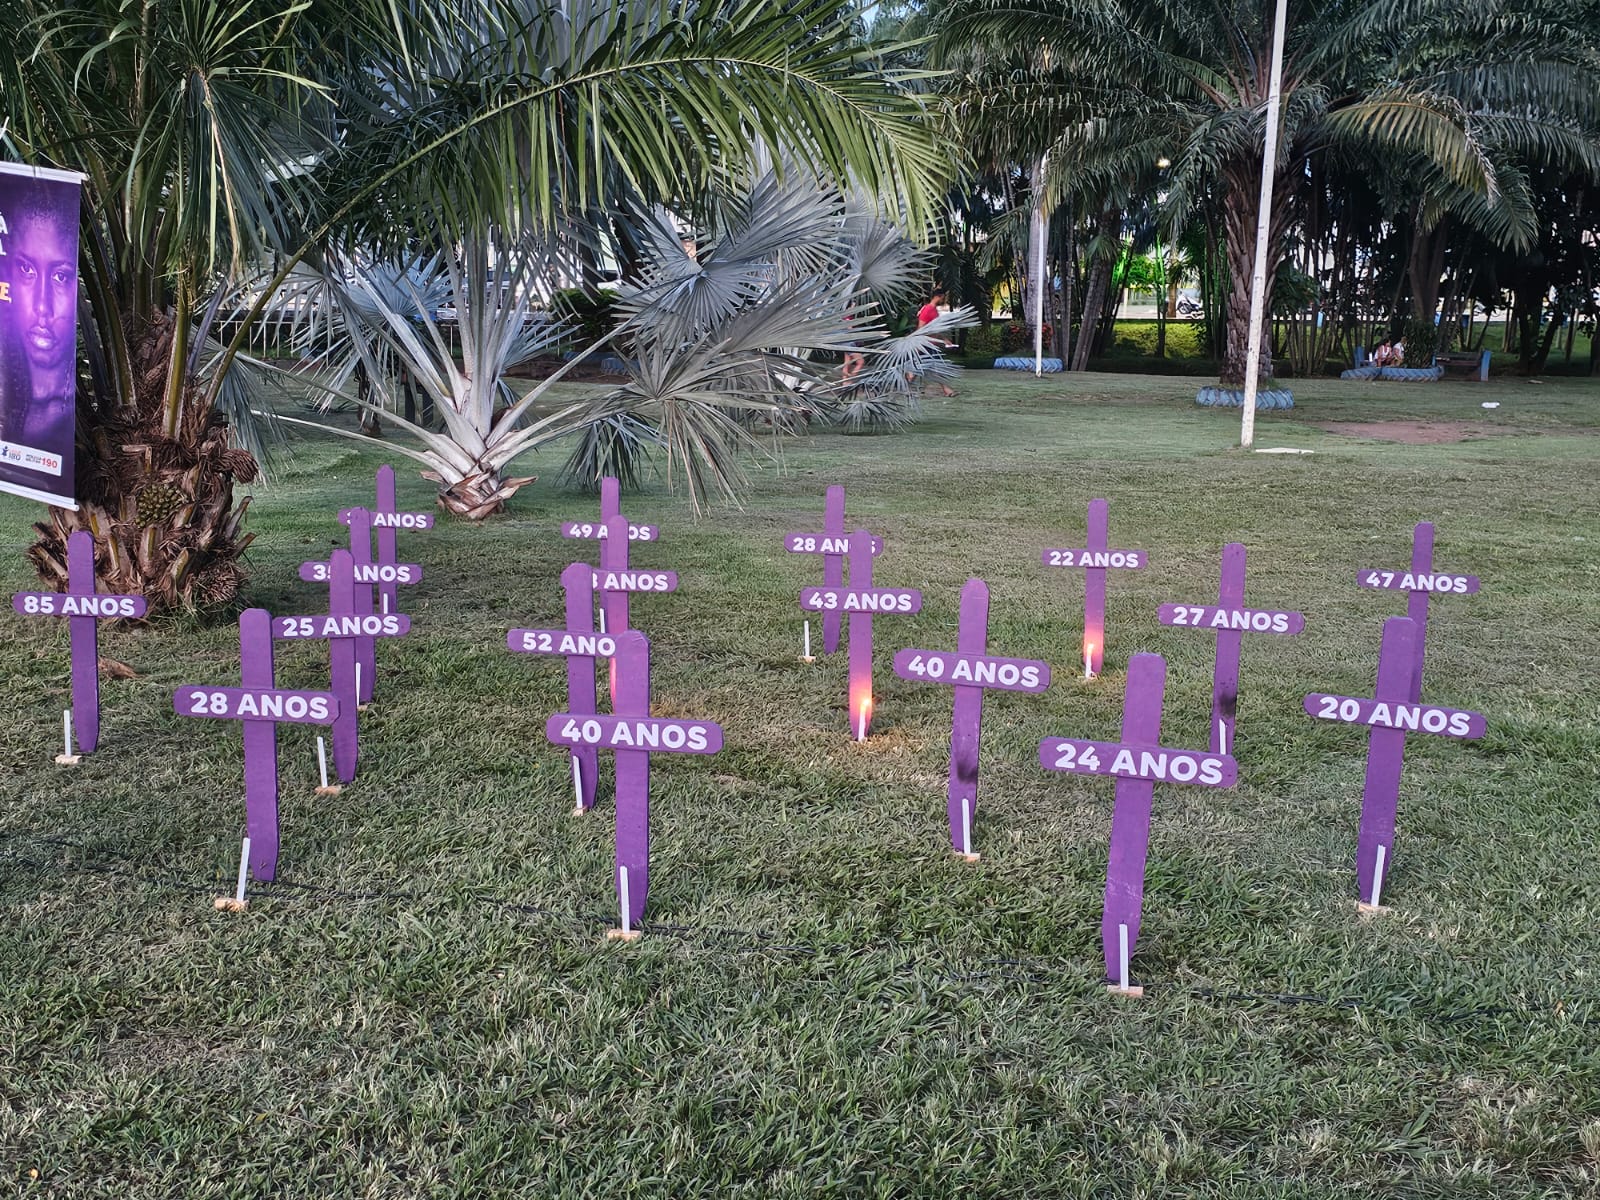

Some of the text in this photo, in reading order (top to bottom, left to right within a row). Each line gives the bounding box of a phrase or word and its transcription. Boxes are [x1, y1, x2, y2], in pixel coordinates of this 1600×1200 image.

[42, 457, 58, 469] 190
[373, 512, 427, 529] ANOS
[569, 523, 651, 541] 49 AOS
[793, 537, 875, 555] 28 AN
[1050, 551, 1139, 568] 22 ANOS
[312, 564, 331, 580] 3
[603, 573, 669, 591] ANOS
[1366, 571, 1468, 593] 47 ANOS
[23, 595, 135, 616] 85 ANOS
[809, 591, 912, 612] 43 ANOS
[282, 615, 399, 637] 25 ANOS
[1172, 606, 1289, 632] 27 ANOS
[522, 632, 616, 657] 52 ANO
[908, 655, 1040, 688] 40 ANOS
[190, 691, 329, 720] 28 ANOS
[1318, 696, 1471, 736] 20 ANOS
[561, 718, 708, 750] 40 ANOS
[1055, 742, 1223, 785] 24 ANOS
